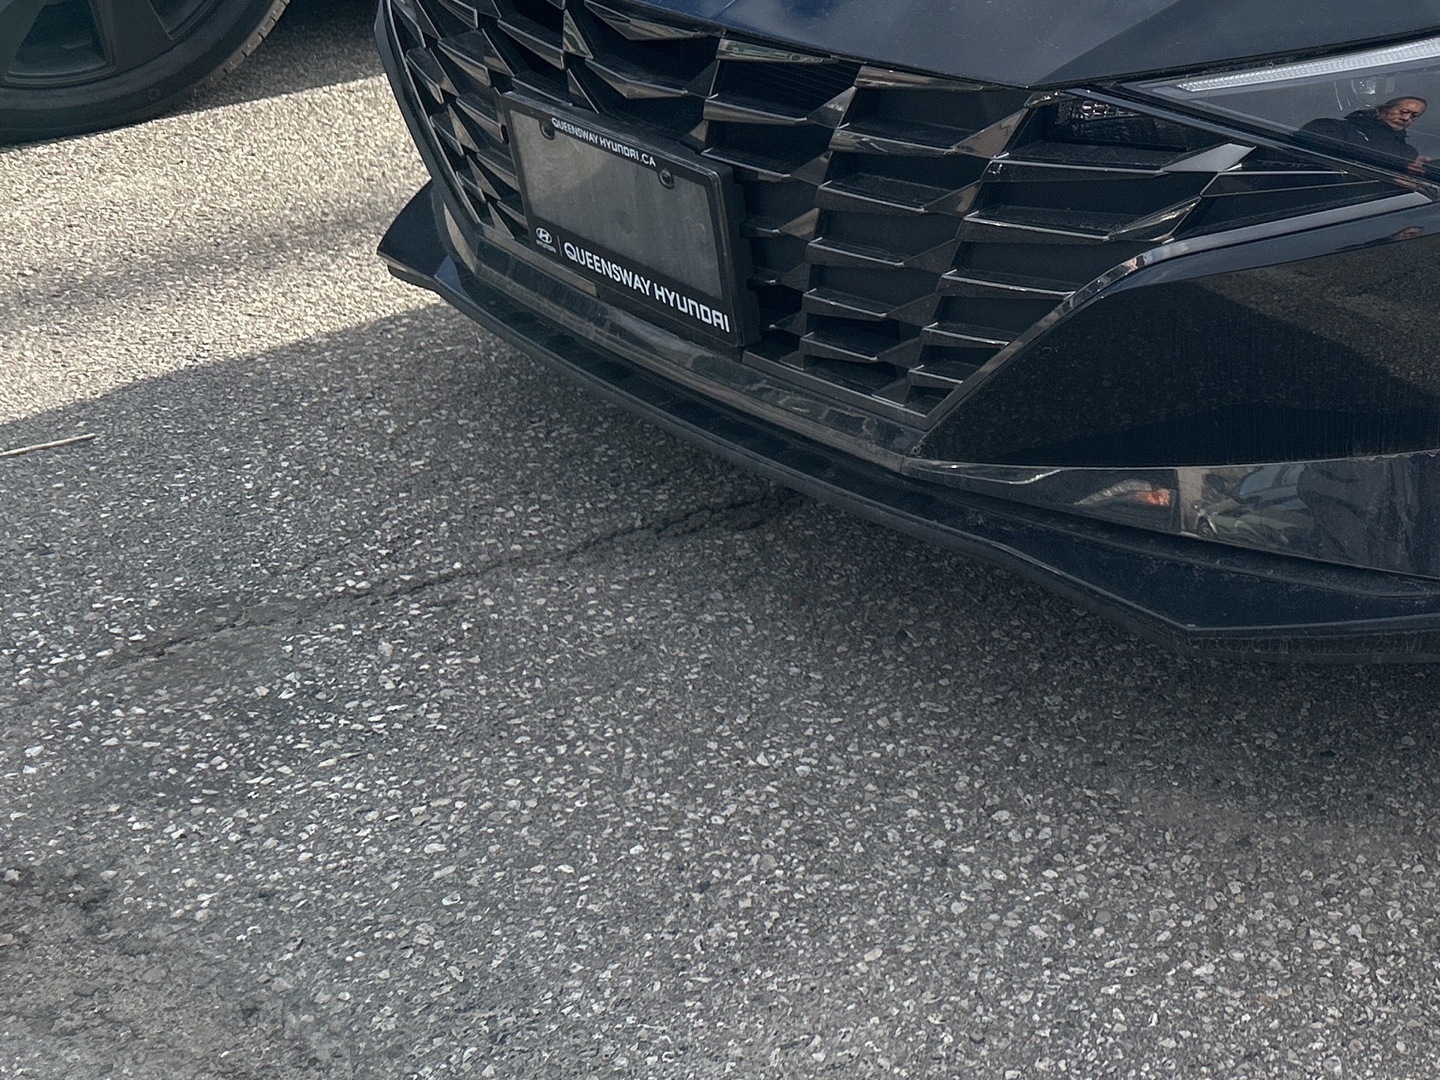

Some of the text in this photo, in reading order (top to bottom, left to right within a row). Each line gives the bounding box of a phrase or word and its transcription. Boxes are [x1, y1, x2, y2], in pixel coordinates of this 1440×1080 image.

[551, 117, 598, 145] QUEENSWAY
[563, 241, 730, 333] QUEENSWAY HYUNDAI
